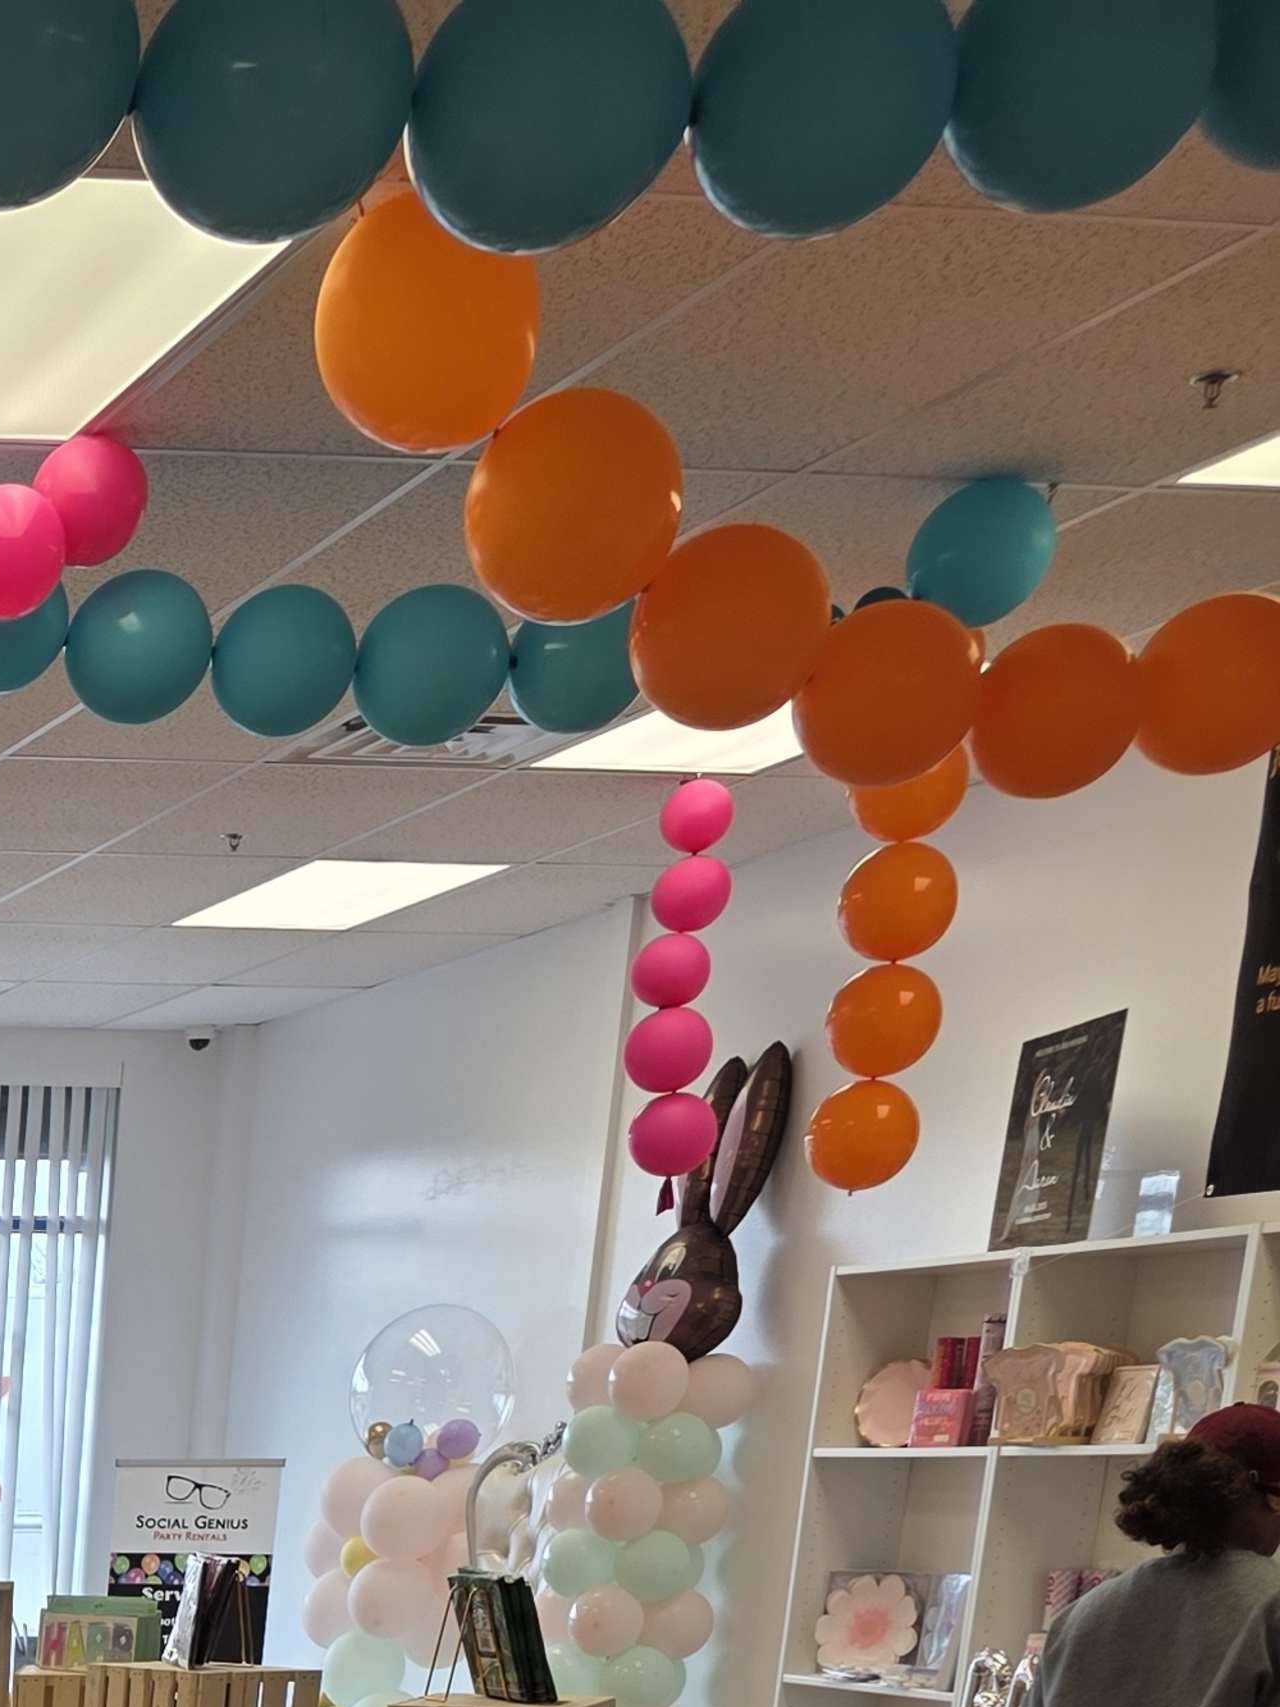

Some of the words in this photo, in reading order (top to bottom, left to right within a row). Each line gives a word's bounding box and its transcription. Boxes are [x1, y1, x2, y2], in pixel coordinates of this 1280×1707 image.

[136, 1515, 188, 1530] SOCIAL
[195, 1515, 249, 1530] GENIUS
[153, 1531, 183, 1541] PARTY
[186, 1531, 227, 1541] RENTALS
